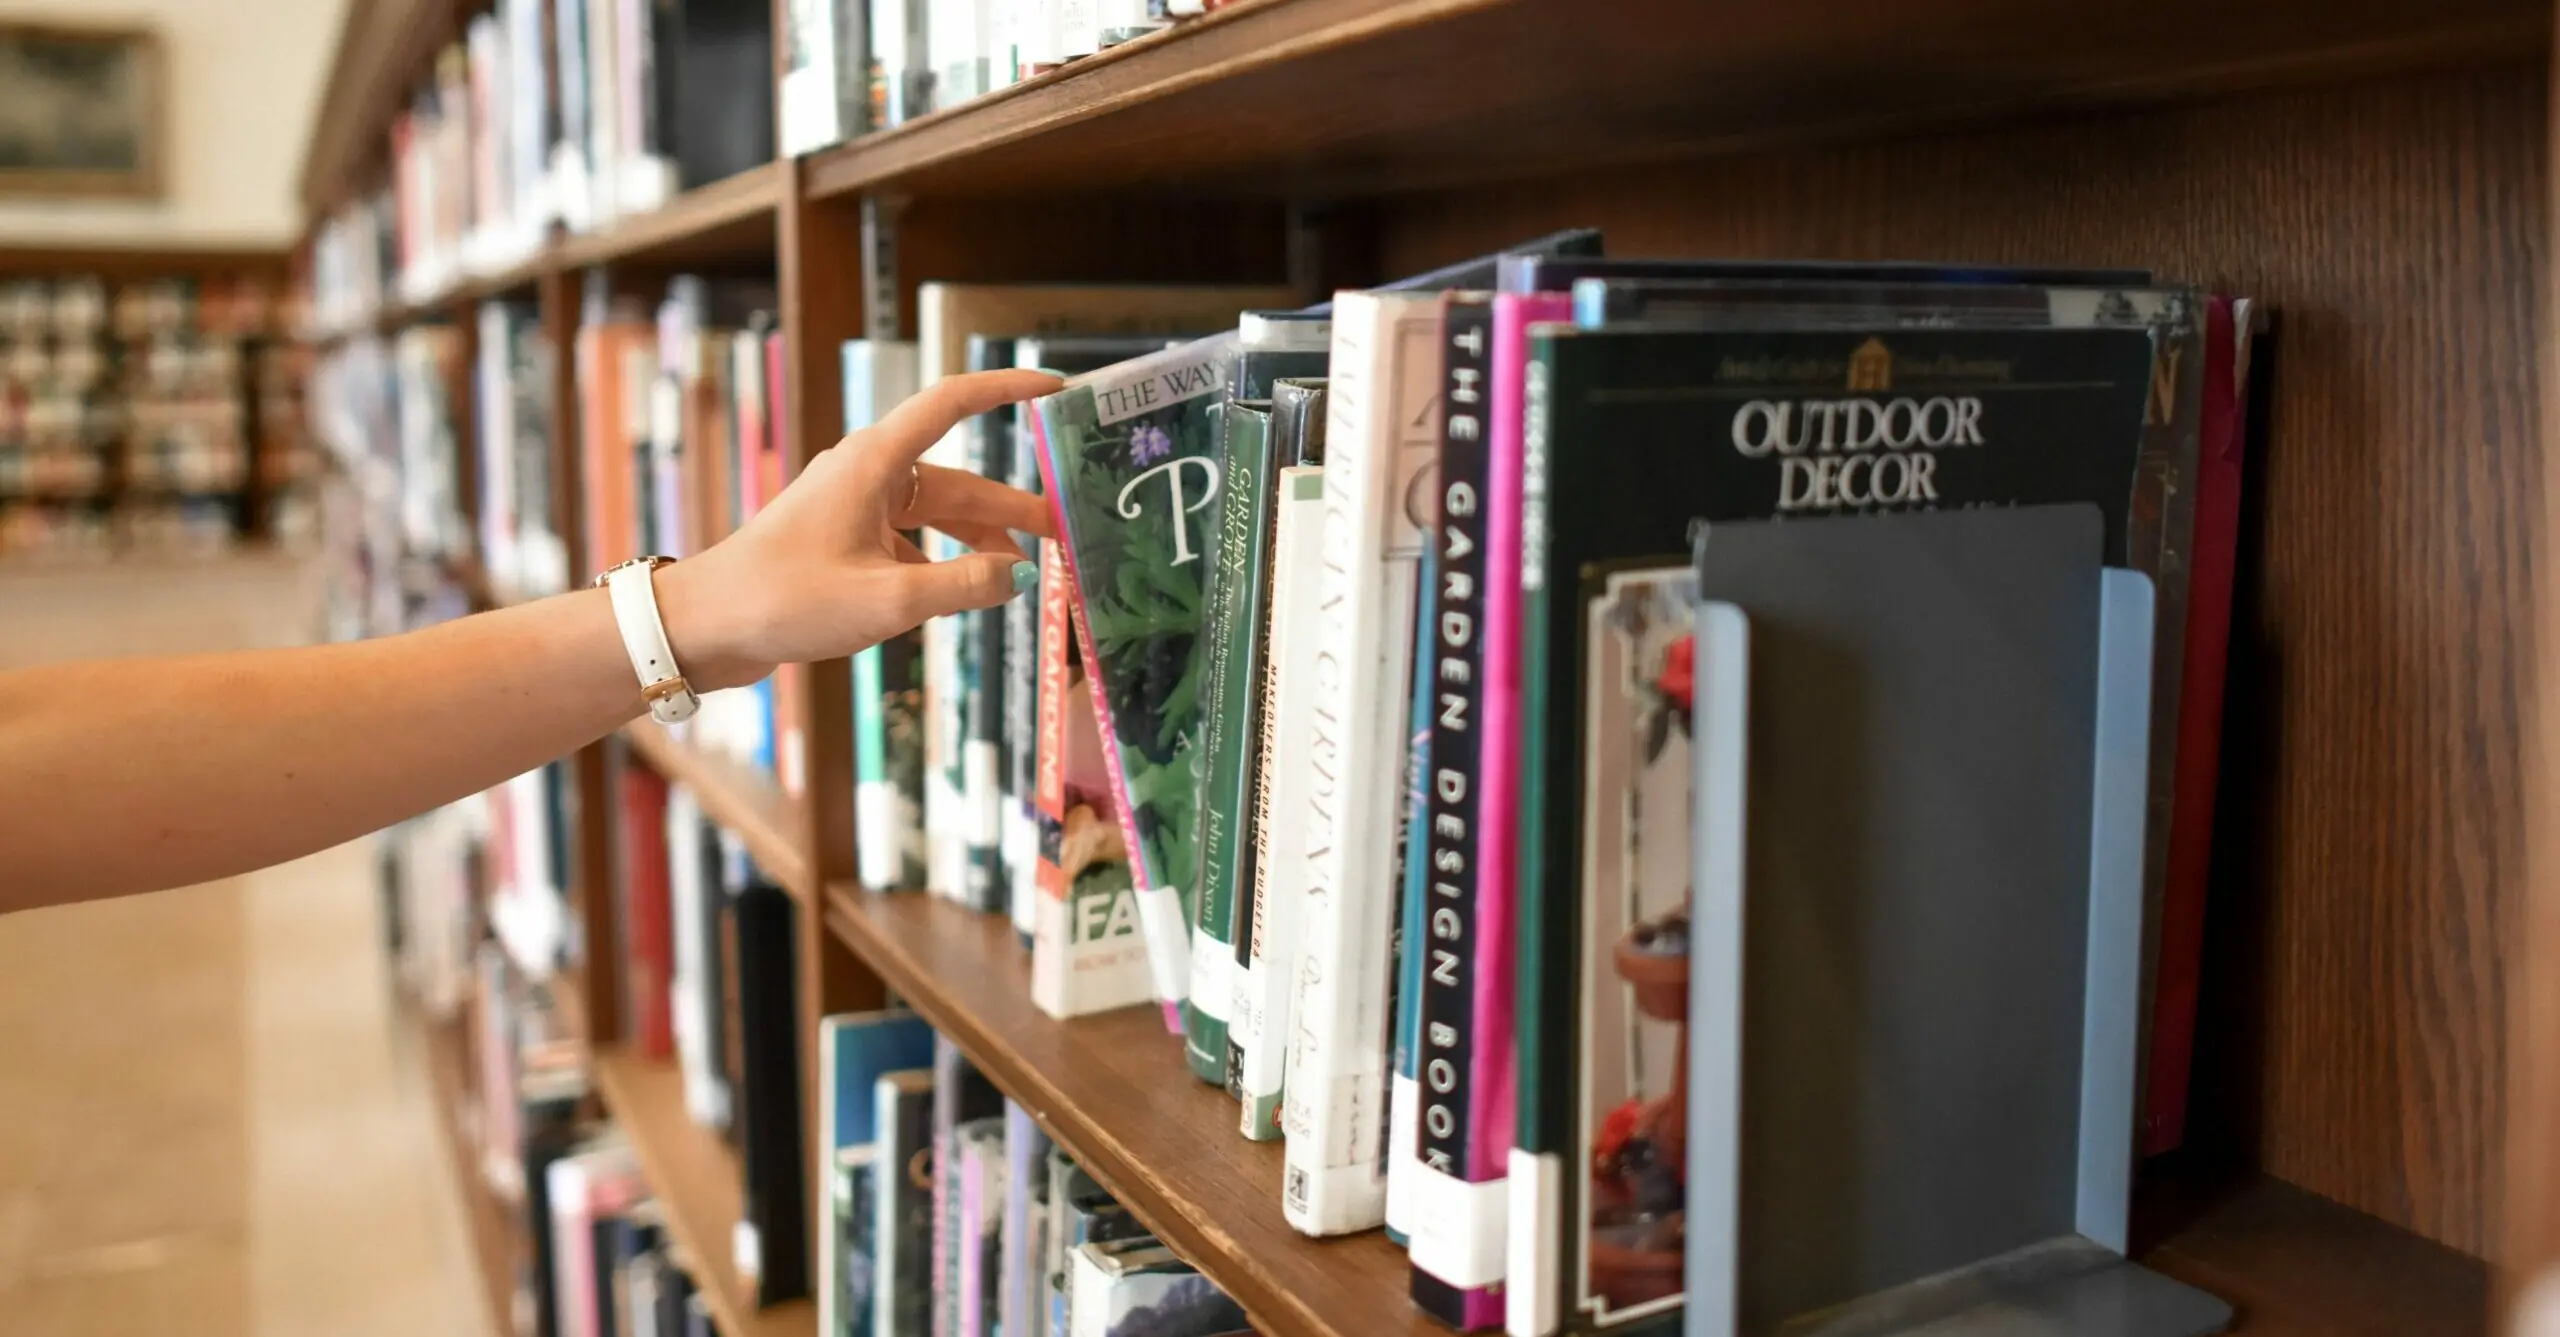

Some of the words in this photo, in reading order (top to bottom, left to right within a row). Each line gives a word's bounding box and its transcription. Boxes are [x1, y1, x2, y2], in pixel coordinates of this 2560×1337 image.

[1098, 378, 1158, 416] THE
[1449, 327, 1483, 443] THE
[1731, 397, 1984, 457] OUTDOOR
[1228, 456, 1238, 489] and
[1778, 454, 1938, 508] DECOR
[1222, 492, 1237, 575] GROVE
[1232, 467, 1252, 575] GARDEN
[1047, 540, 1062, 623] MILY
[1225, 587, 1233, 605] The
[1437, 482, 1478, 730] GARDEN
[1222, 610, 1231, 644] Italian
[1041, 625, 1061, 800] GARDENS
[1215, 714, 1224, 752] Garden
[1264, 664, 1277, 765] MAKEOVERS
[1261, 773, 1271, 820] FROM
[1304, 651, 1342, 907] GARDENS
[1207, 802, 1224, 854] John
[1258, 829, 1267, 858] THE
[1203, 860, 1221, 921] Dixon
[1254, 866, 1265, 930] BUDGET
[1429, 769, 1468, 986] DESIGN
[1076, 889, 1141, 943] FA
[1423, 1021, 1456, 1173] BOOK
